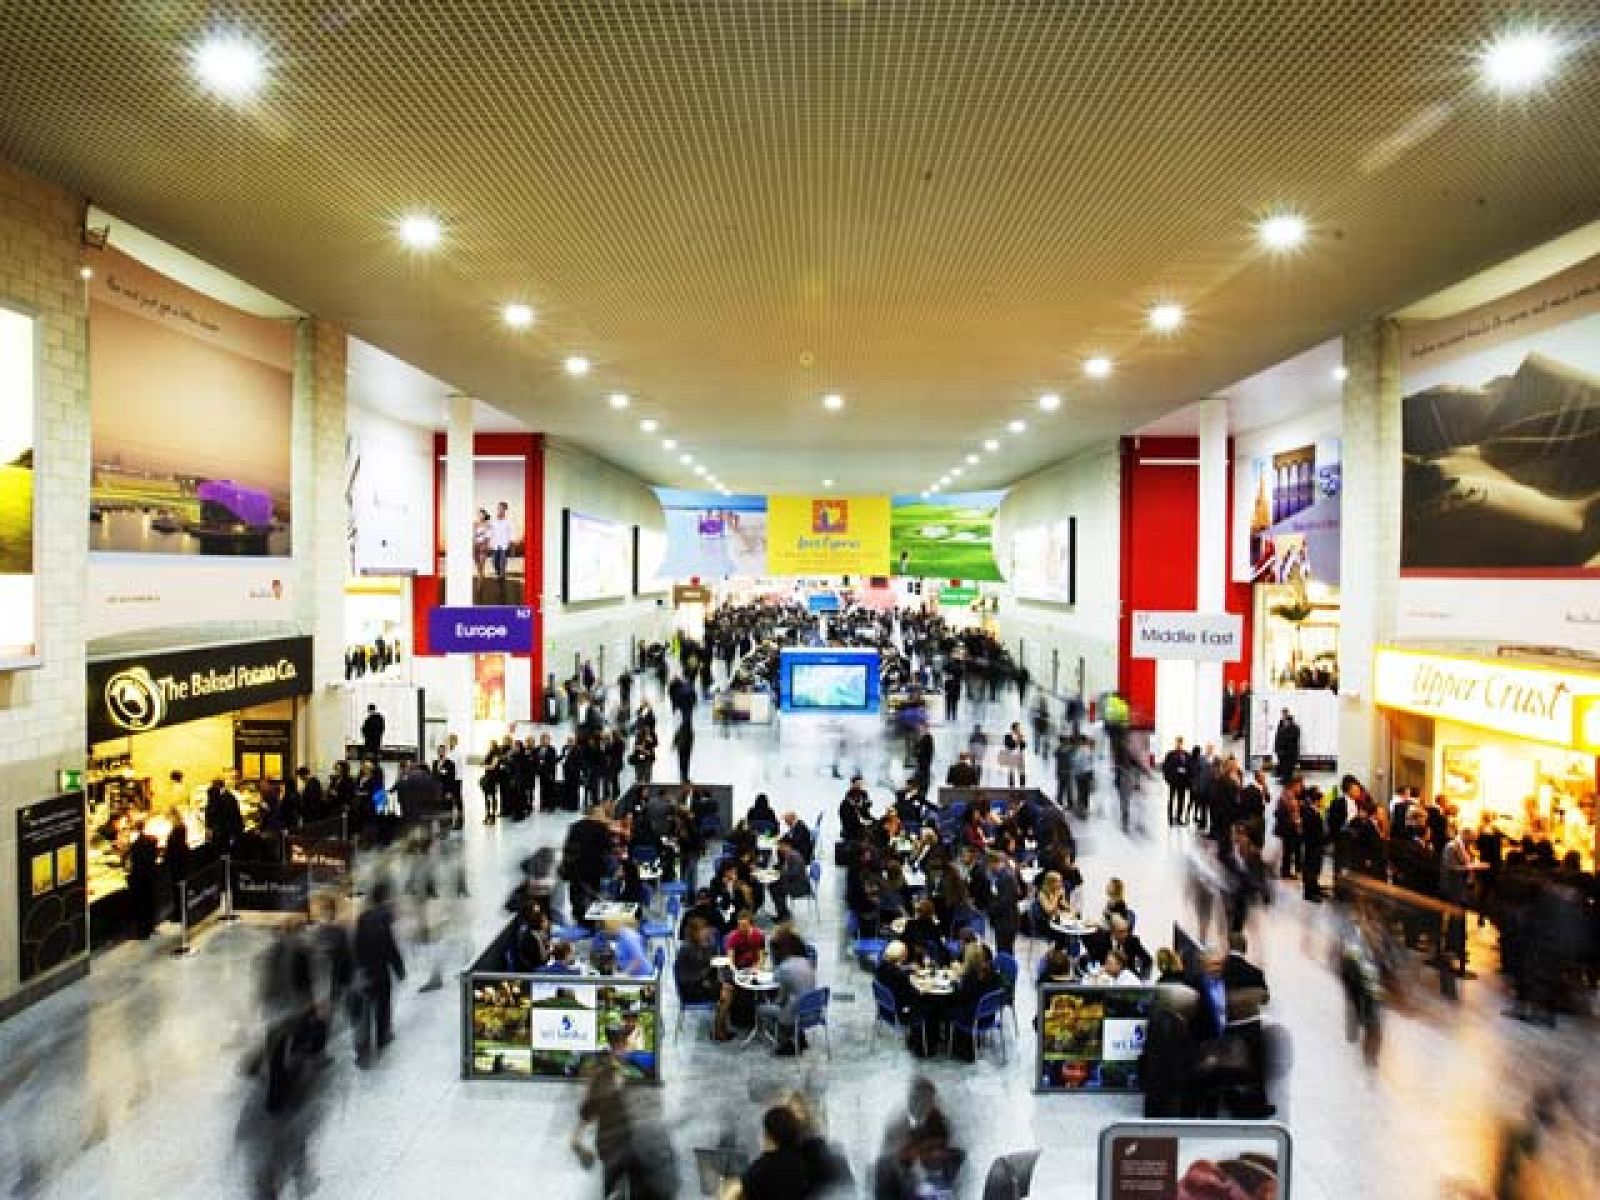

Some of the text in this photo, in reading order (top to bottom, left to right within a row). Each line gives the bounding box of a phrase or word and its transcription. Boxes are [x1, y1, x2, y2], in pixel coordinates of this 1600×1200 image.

[454, 621, 509, 641] Europe
[1141, 626, 1234, 646] Middle East
[158, 674, 189, 701] The
[191, 666, 236, 696] Baked
[237, 664, 276, 688] Potato
[276, 659, 298, 681] Co.
[1411, 662, 1571, 721] Upper Crust
